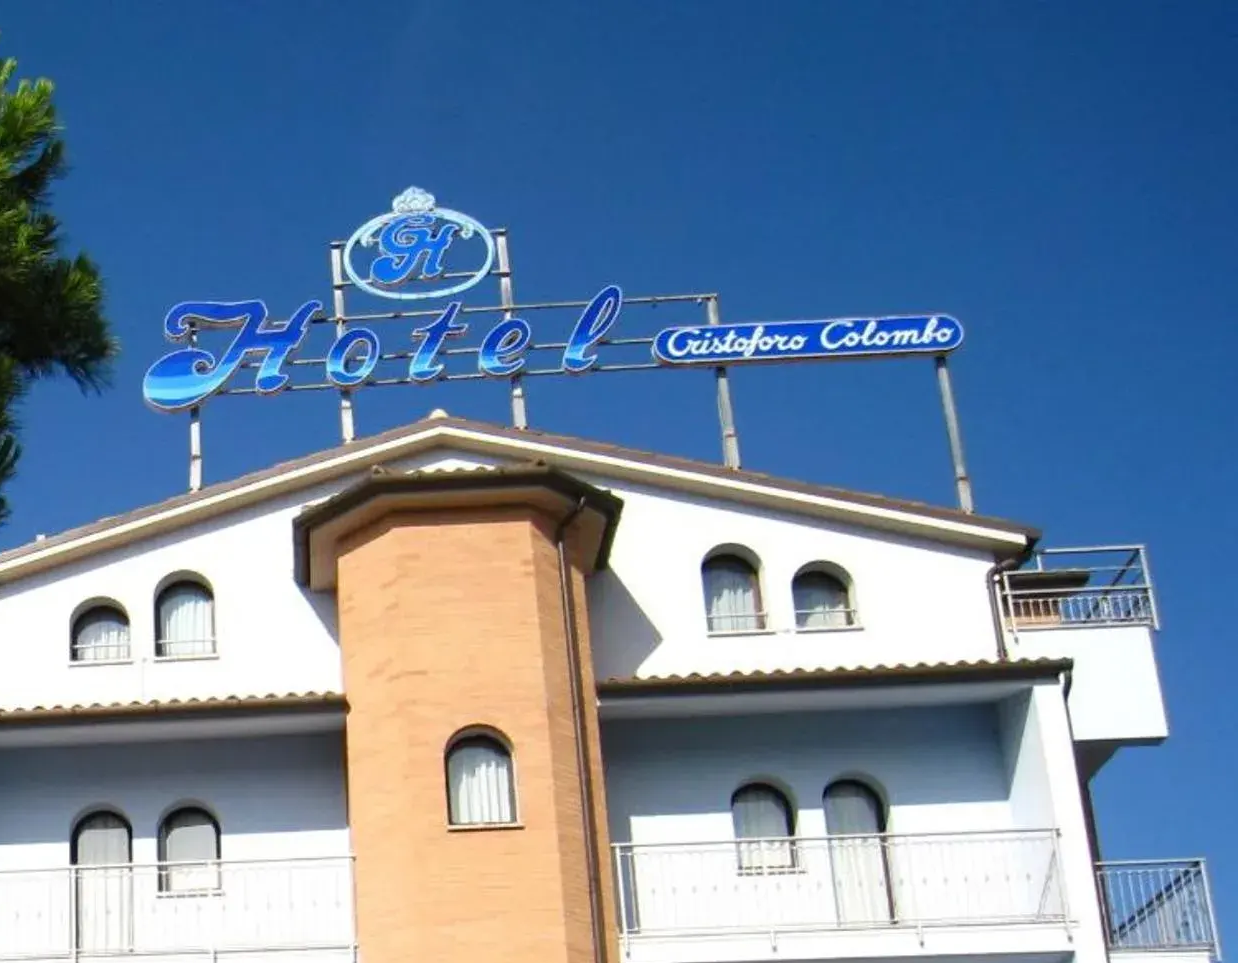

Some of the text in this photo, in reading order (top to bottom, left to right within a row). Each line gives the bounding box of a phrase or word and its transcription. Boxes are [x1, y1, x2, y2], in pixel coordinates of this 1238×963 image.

[143, 284, 622, 410] Hotel
[666, 316, 955, 358] Cristoforo Colombo
